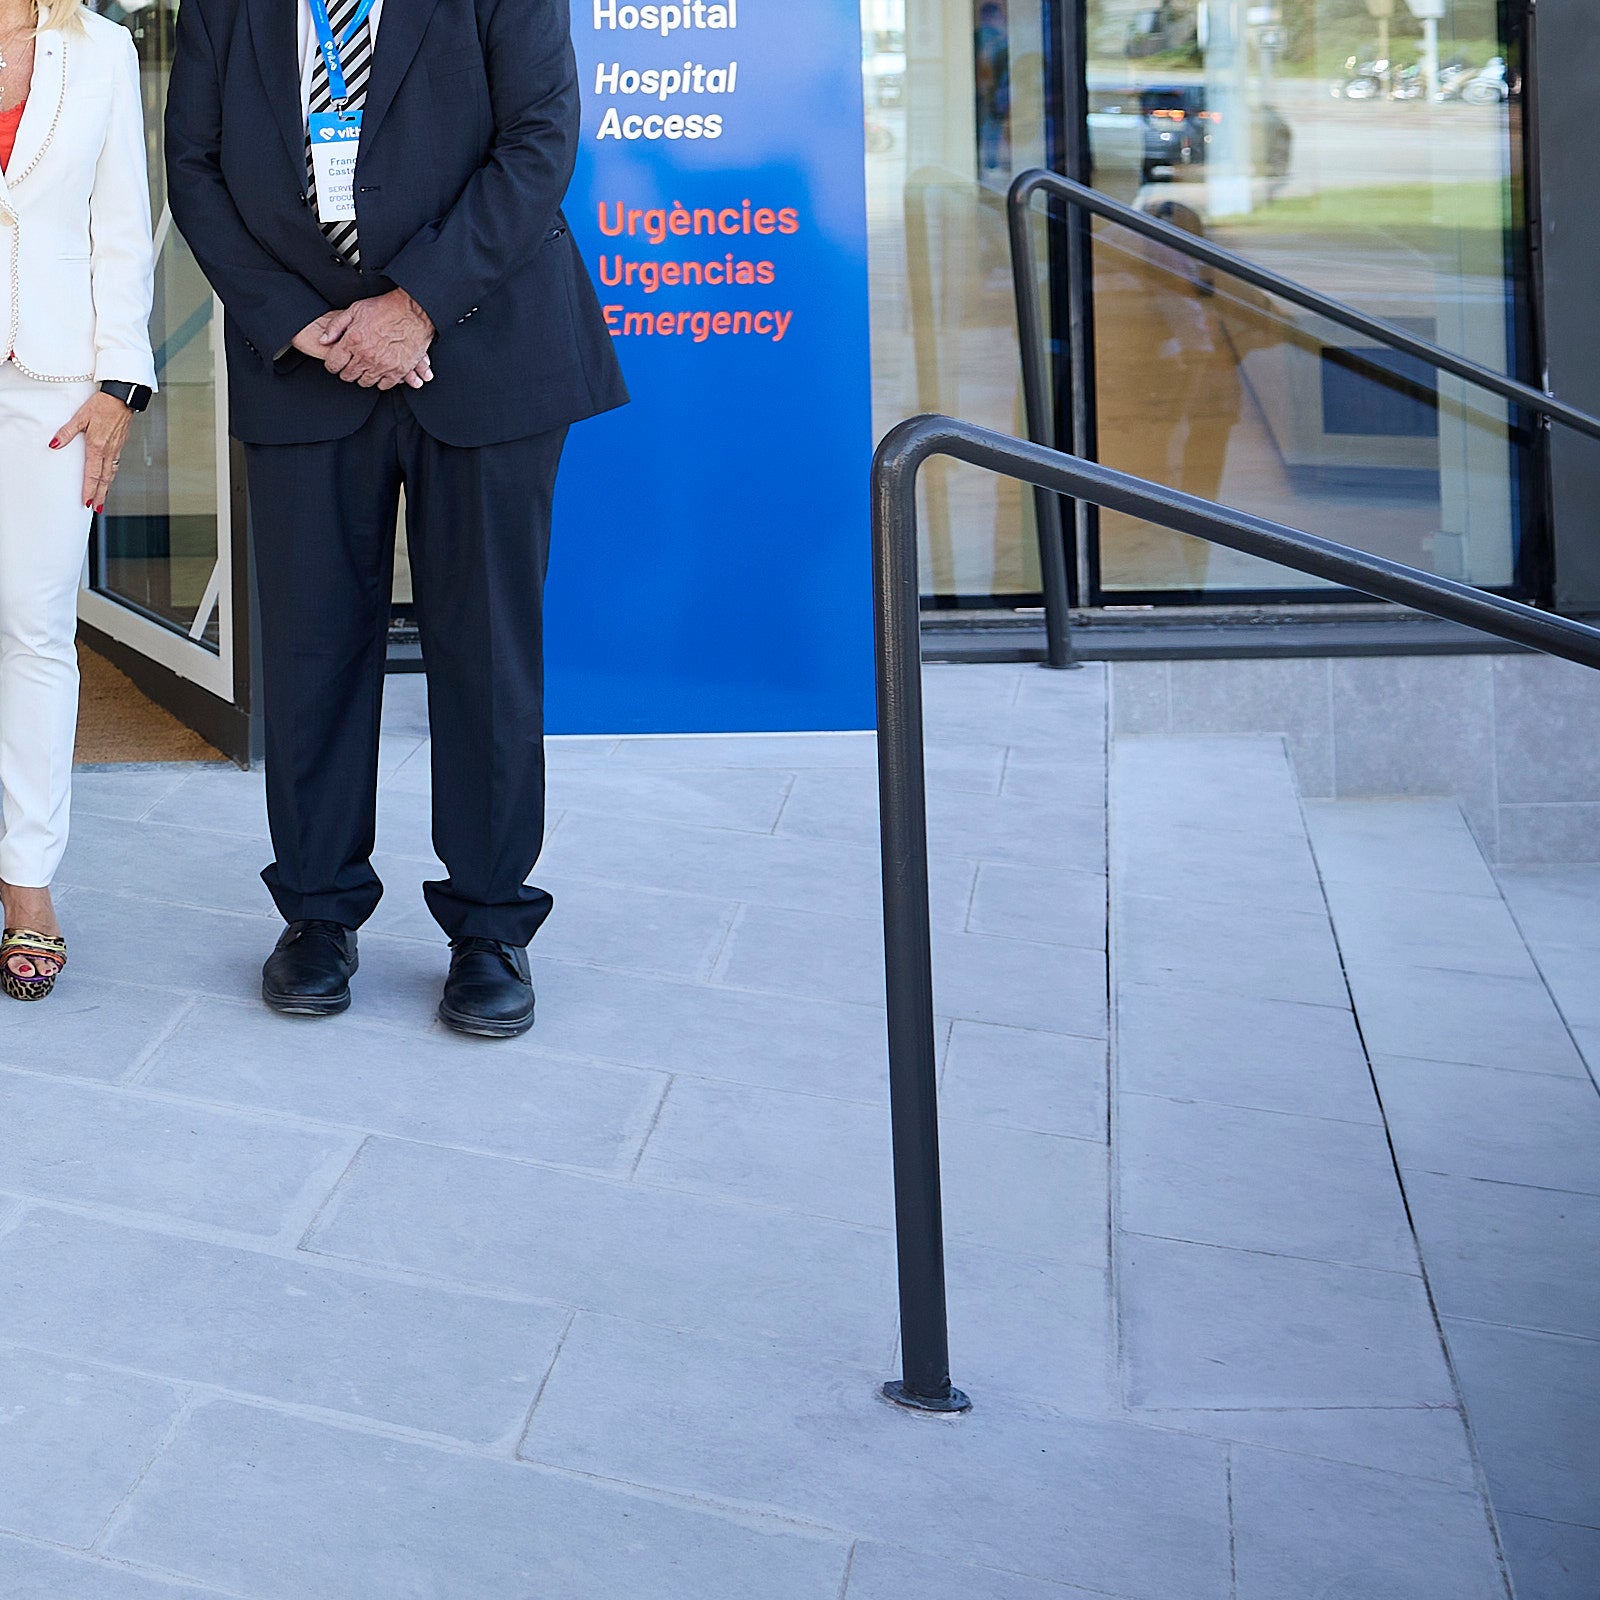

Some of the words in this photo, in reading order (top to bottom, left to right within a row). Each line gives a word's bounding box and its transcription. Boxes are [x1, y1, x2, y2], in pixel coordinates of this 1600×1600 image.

[594, 61, 738, 101] Hospital
[596, 108, 724, 140] Access
[598, 199, 800, 245] Urgències
[599, 253, 775, 293] Urgencias
[603, 304, 793, 343] Emergency
